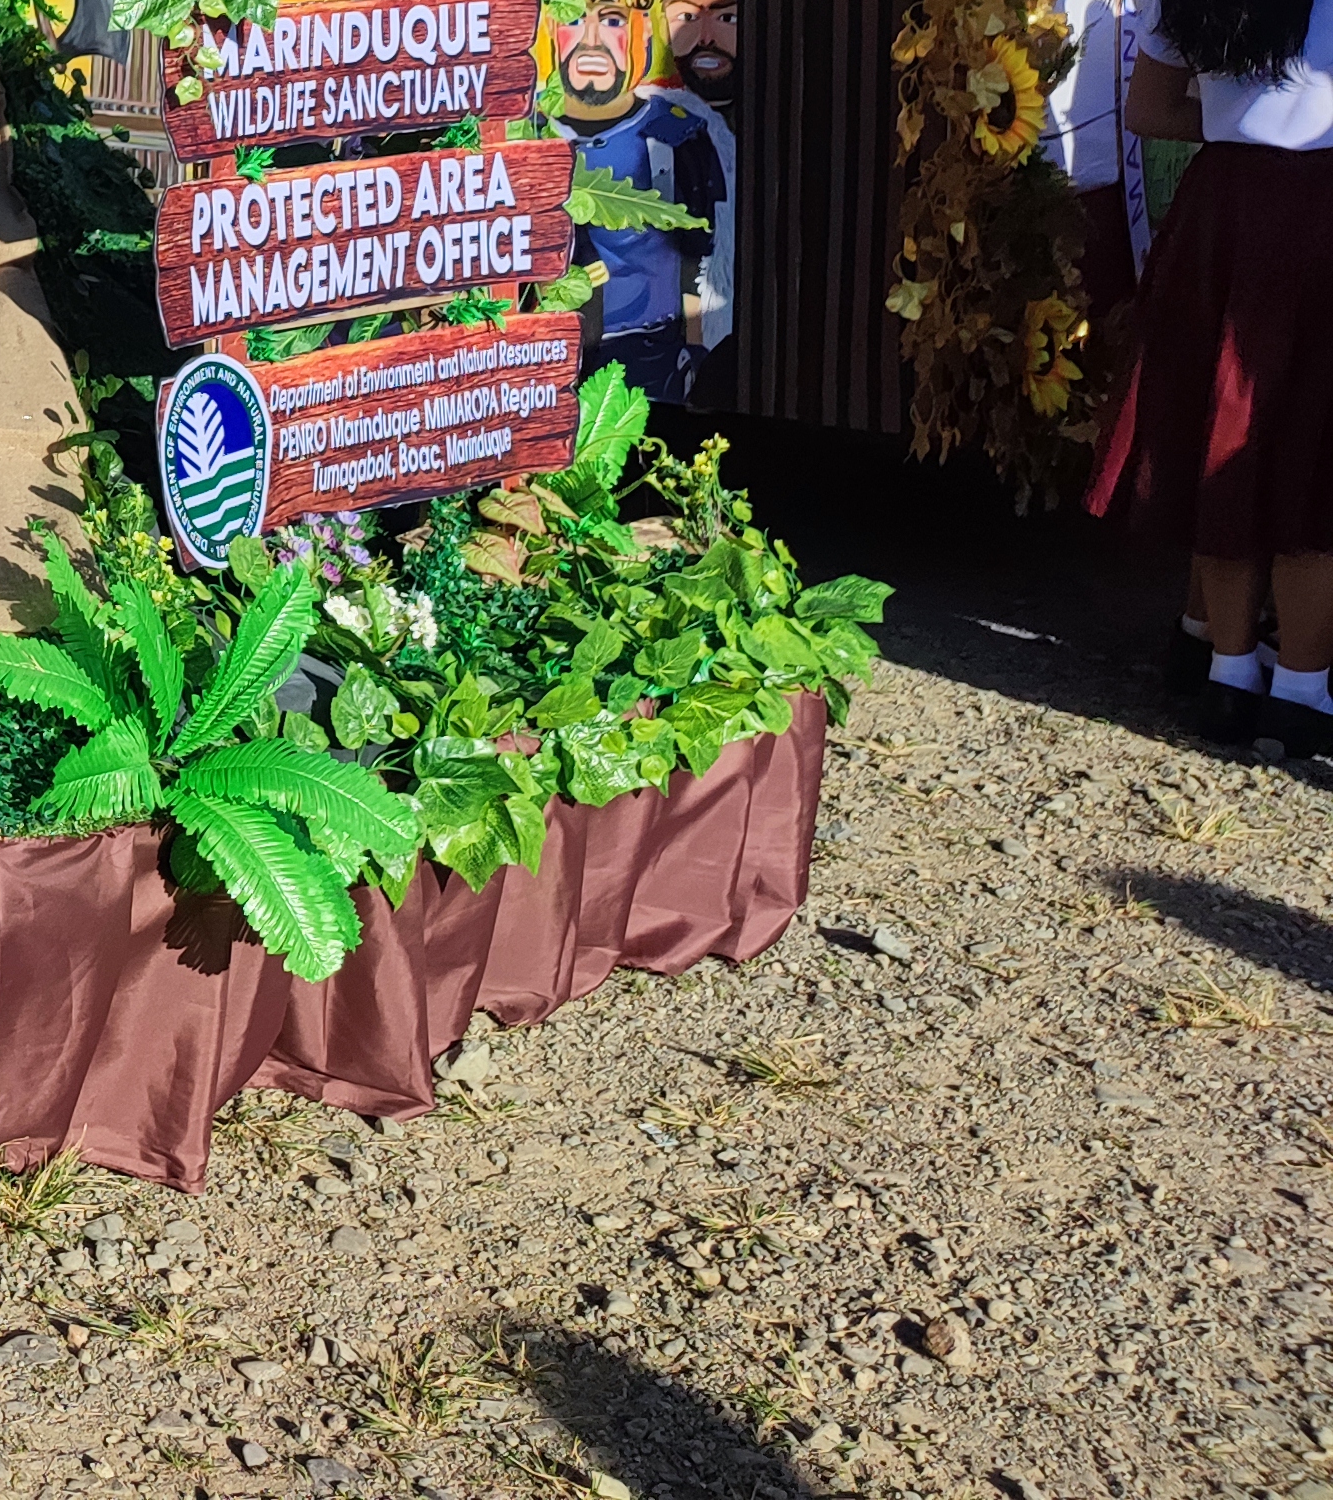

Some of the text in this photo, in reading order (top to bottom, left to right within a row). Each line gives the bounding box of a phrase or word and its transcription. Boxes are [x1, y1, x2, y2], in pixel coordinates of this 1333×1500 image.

[203, 1, 491, 79] MARINDUQUE
[207, 64, 488, 140] WILDLIFE SANCTUARY
[191, 151, 516, 254] PROTECTED AREA
[189, 215, 532, 327] MANAGEMENT OFFICE
[270, 338, 568, 415] Department of Environment and Natural Resources
[166, 366, 264, 552] DEPARTMENT OF ENVIRONMENT AND NATURAL RESOURCES
[279, 380, 557, 460] PENRO Marinduque MIMAROPA Region
[312, 425, 512, 493] Tumagabok, Boac, Marinduque
